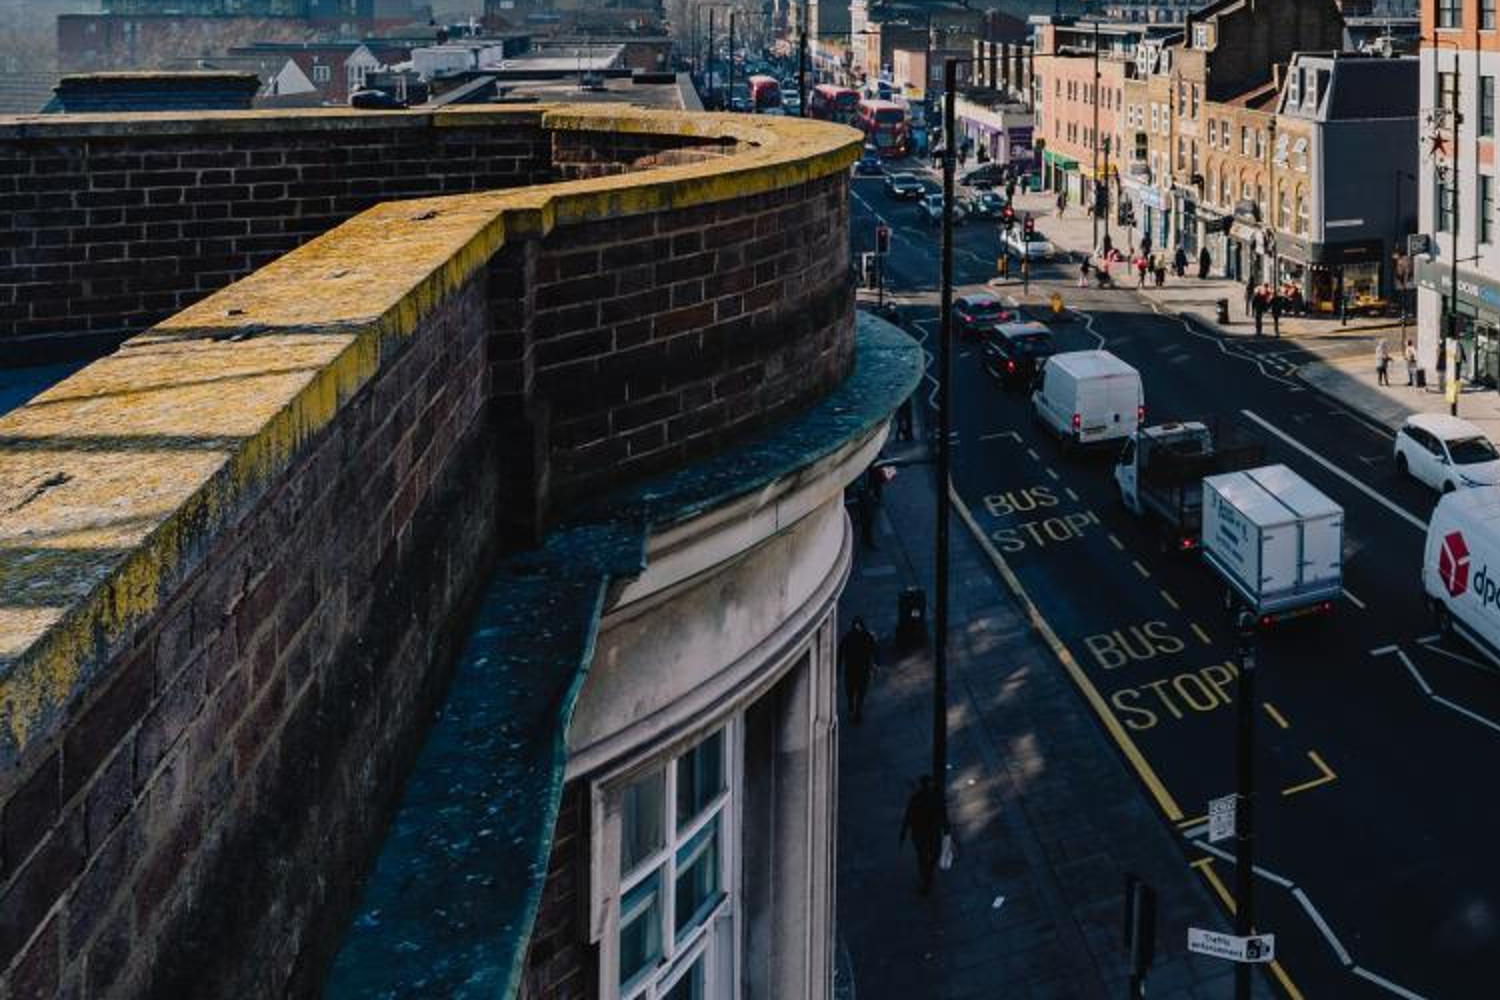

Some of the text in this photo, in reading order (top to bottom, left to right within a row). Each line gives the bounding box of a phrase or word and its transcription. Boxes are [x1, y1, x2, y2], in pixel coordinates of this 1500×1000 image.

[983, 486, 1059, 517] BUS
[992, 513, 1090, 552] STOP
[1084, 621, 1184, 669] BUS
[1111, 665, 1233, 730] STOP
